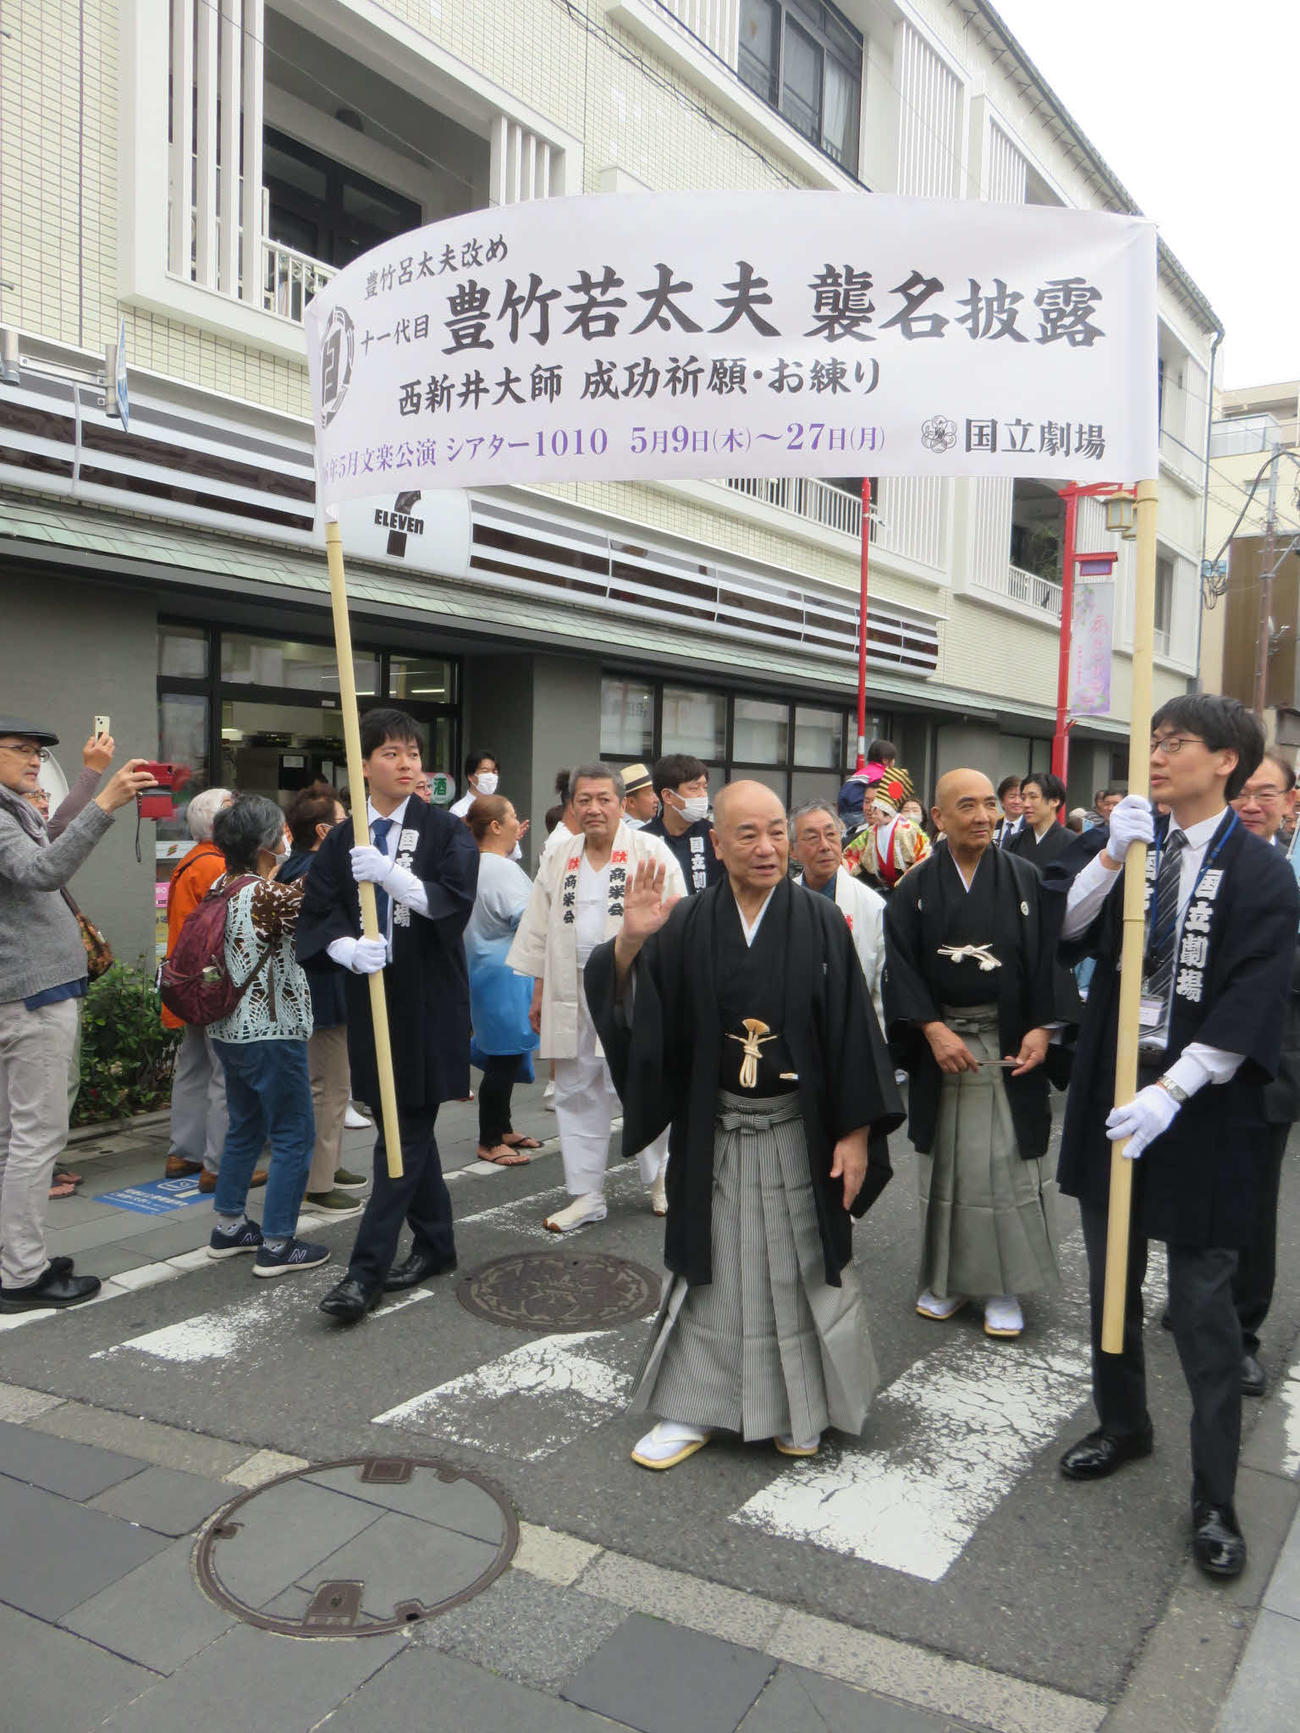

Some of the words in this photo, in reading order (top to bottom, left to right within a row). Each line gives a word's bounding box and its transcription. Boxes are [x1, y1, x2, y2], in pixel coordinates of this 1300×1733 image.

[364, 234, 508, 300] 豊竹呂太夫改め
[360, 313, 430, 357] 十一代目
[441, 261, 782, 355] 豊竹若太夫
[803, 264, 1106, 348] 襲名披露
[399, 363, 563, 417] 西新井大師
[446, 427, 608, 464] シアター1010
[964, 417, 1106, 461] 国立劇場
[433, 777, 447, 796] 酒
[394, 828, 419, 928] 国立場
[689, 836, 707, 894] 国立劇
